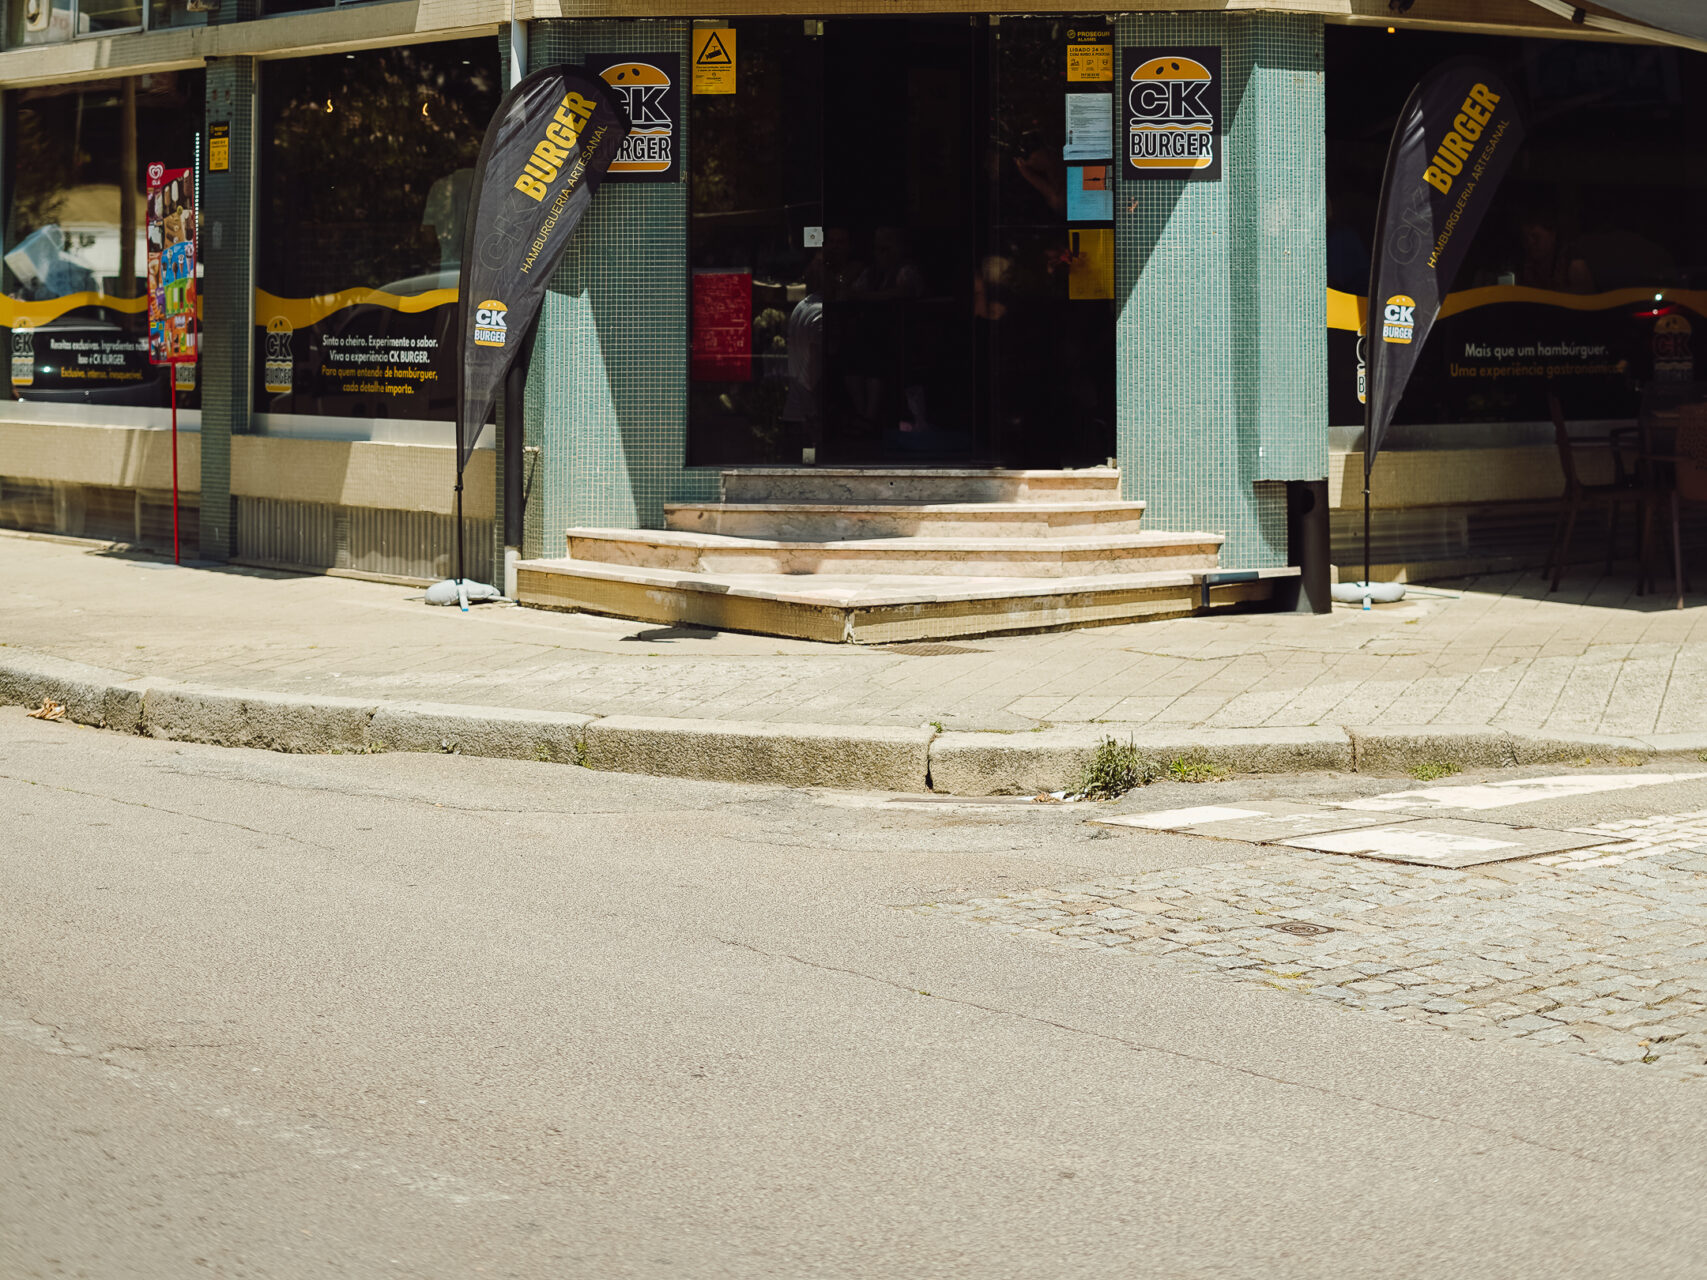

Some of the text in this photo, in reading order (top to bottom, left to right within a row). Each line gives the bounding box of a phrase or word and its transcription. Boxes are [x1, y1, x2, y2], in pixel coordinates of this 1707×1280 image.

[1129, 81, 1213, 118] CK
[514, 91, 598, 202] BURGER
[613, 136, 672, 161] RGER
[1129, 131, 1213, 157] BURGER
[1422, 83, 1501, 195] BURGER
[520, 124, 608, 274] HAMBURGUERIA ARTESANAL
[1427, 120, 1510, 269] HAMBURGUERIA ARTESANAL
[475, 309, 508, 327] CK
[1384, 305, 1416, 323] CK
[322, 334, 439, 349] Sinta o cheiro. Experimente o sabor.
[475, 329, 506, 343] BURGER
[1383, 325, 1413, 339] BURGER
[265, 332, 293, 359] CK
[1465, 341, 1609, 360] Mais que um hambúrguer.
[329, 350, 431, 365] Viva a experiência CK BURGER.
[321, 364, 438, 382] Para quem entende de hambúrguer,
[1450, 363, 1477, 378] Uma
[1479, 360, 1543, 381] experiência
[343, 380, 415, 396] cada detalhe importa.
